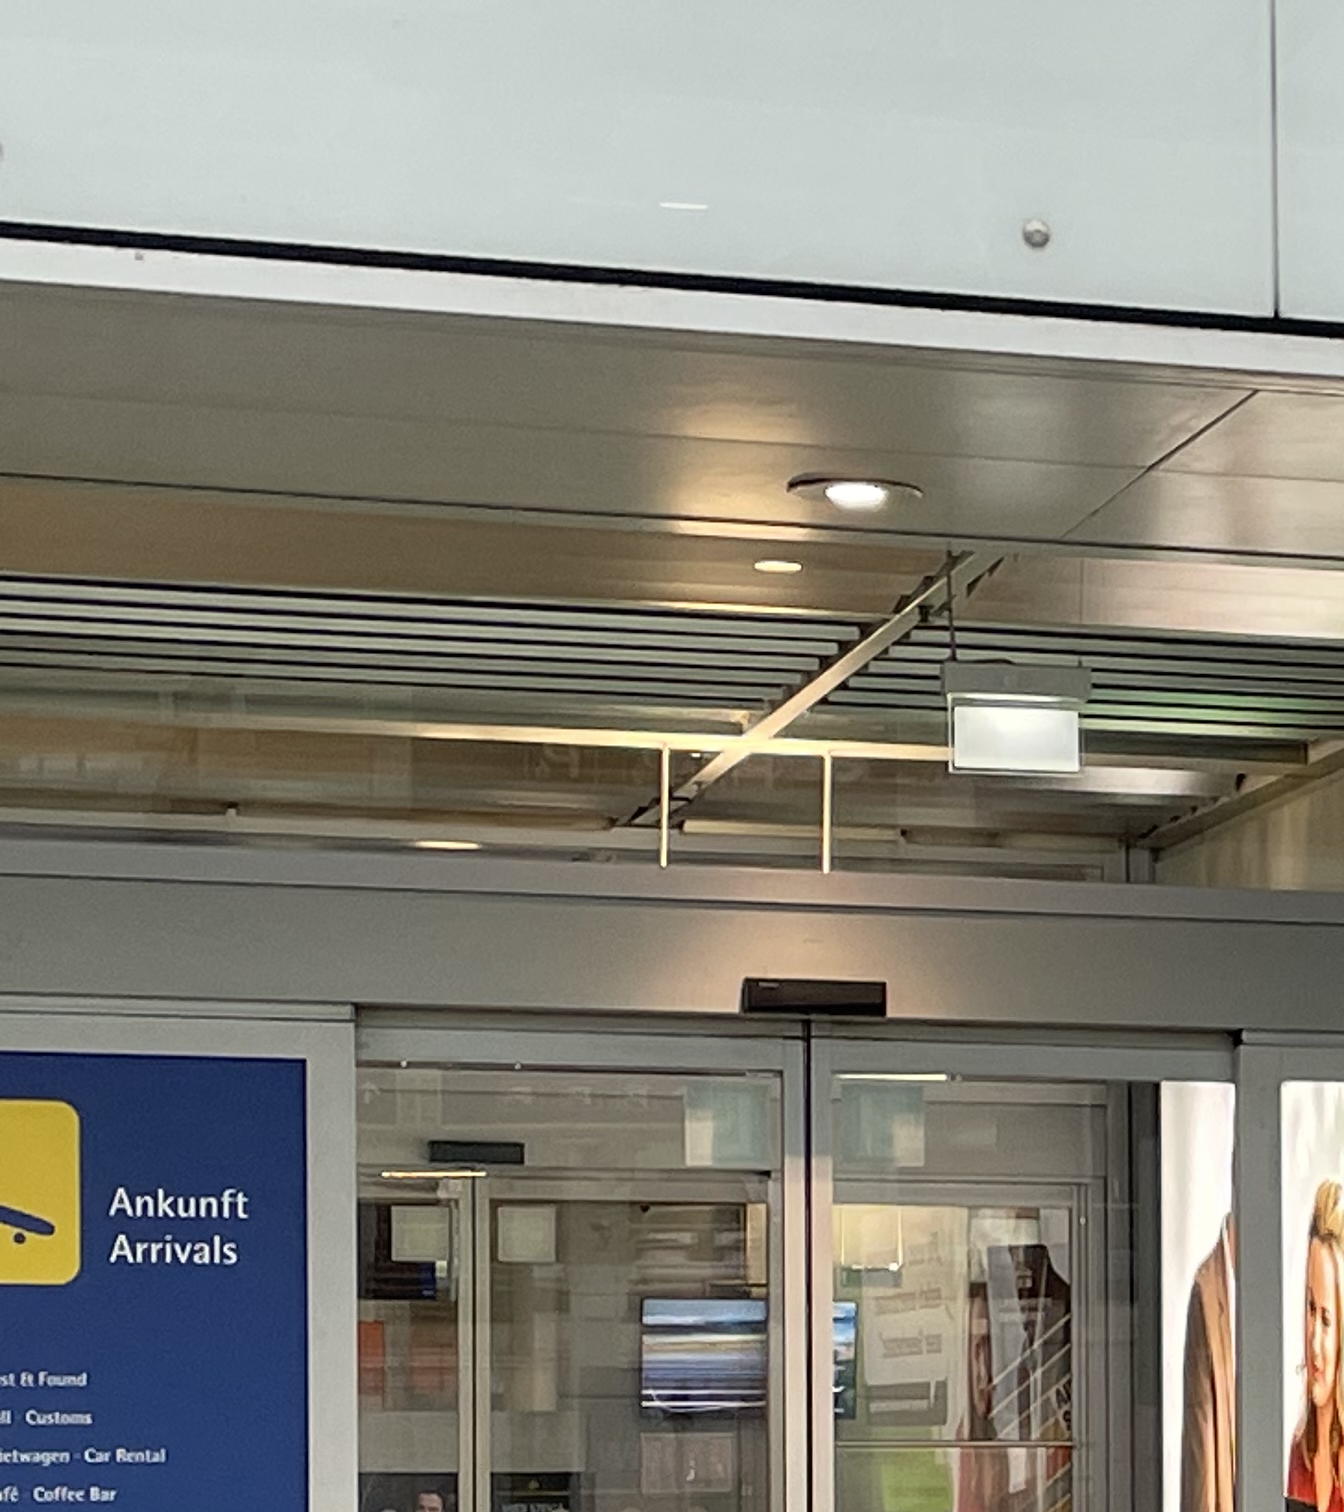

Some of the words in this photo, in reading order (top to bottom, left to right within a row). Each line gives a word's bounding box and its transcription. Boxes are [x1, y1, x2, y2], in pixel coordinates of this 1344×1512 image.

[108, 1187, 249, 1219] Ankunft
[108, 1234, 239, 1266] Arrivals
[38, 1371, 88, 1387] Found
[25, 1410, 93, 1425] Customs
[84, 1448, 111, 1463] Car
[115, 1448, 167, 1463] Rental
[33, 1486, 86, 1502] Coffee
[89, 1486, 118, 1501] Bar
